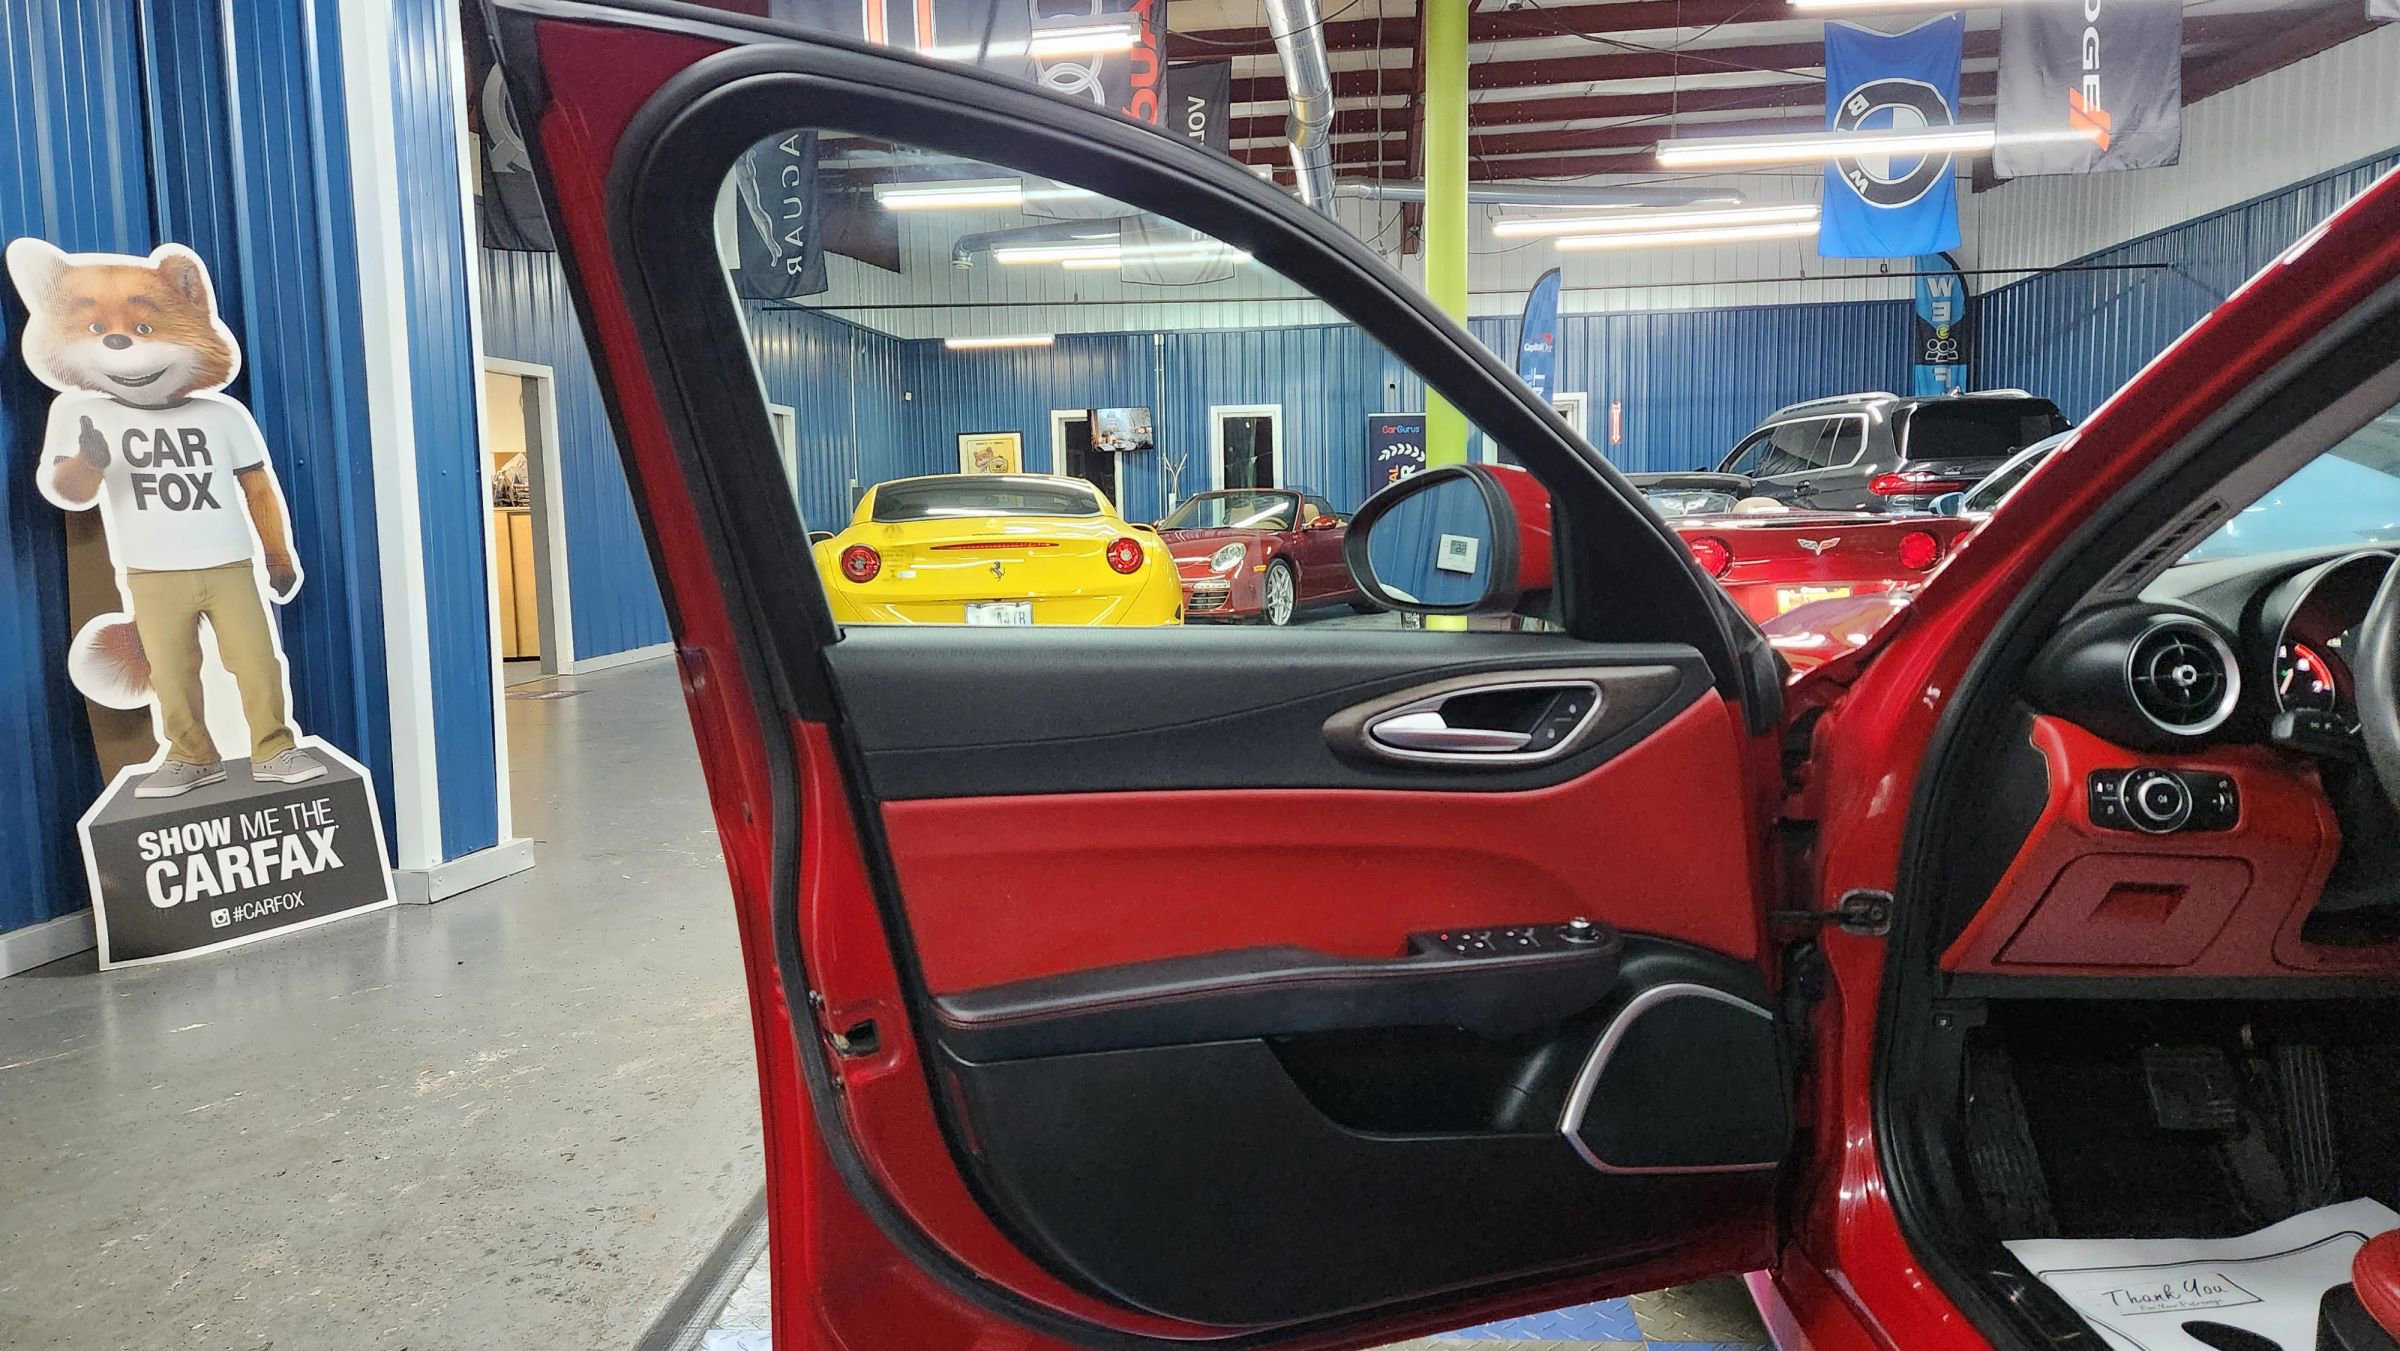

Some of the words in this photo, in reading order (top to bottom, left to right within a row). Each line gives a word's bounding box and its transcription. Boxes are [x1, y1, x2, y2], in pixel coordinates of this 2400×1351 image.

[121, 427, 214, 468] CAR
[1382, 425, 1420, 434] CarGurus
[130, 472, 222, 511] FOX
[137, 816, 231, 861] SHOW
[239, 807, 283, 841] ME
[284, 797, 335, 831] THE
[145, 825, 345, 909] CARFAX
[232, 890, 305, 924] #CARFOX
[2101, 1284, 2180, 1307] Thank
[2183, 1278, 2228, 1298] You
